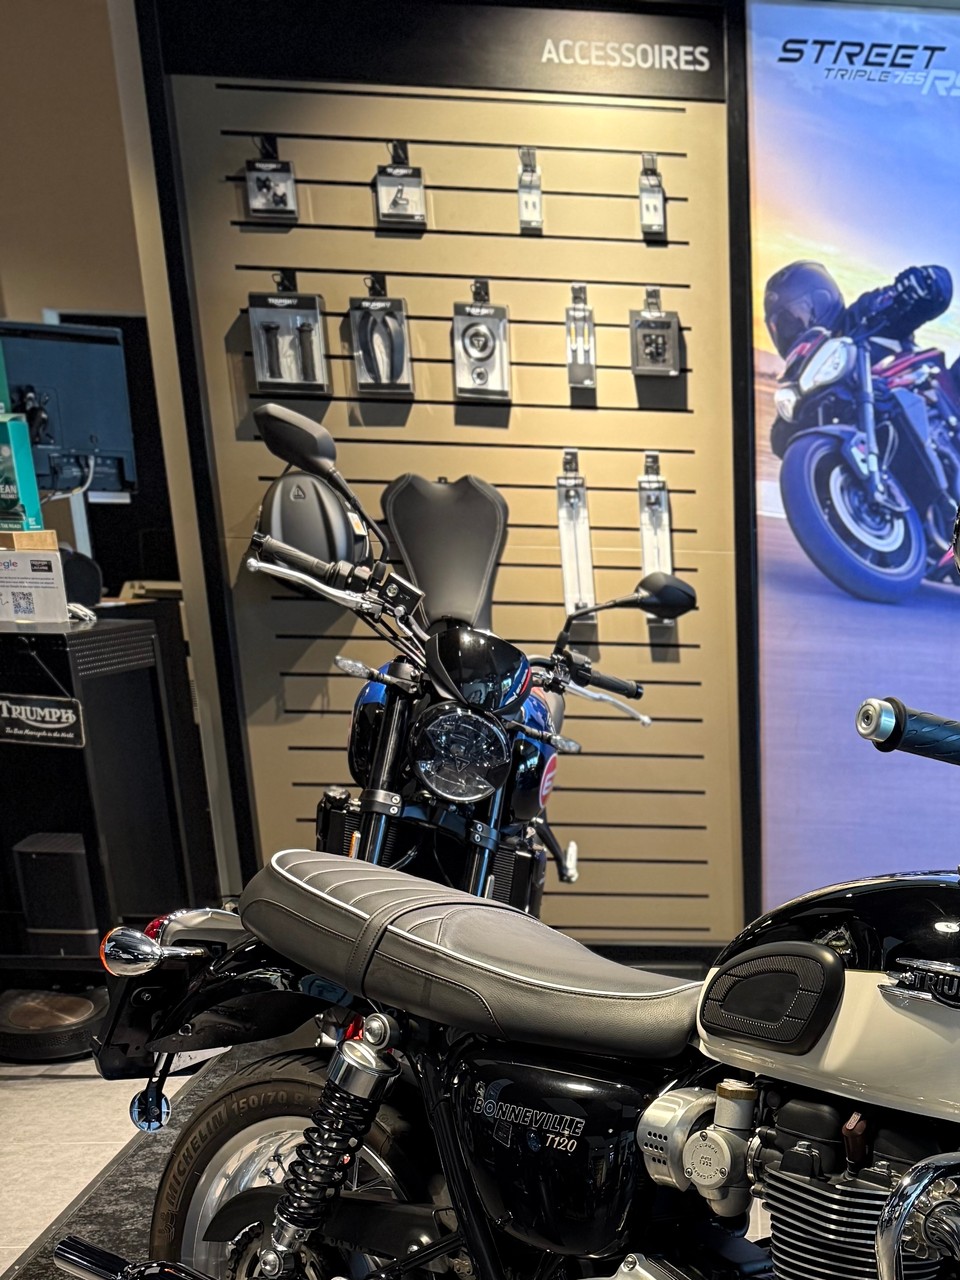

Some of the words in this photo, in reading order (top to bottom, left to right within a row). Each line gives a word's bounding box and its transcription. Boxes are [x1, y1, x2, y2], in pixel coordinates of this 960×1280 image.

[541, 38, 711, 72] ACCESSOIRES
[778, 38, 946, 69] STREET
[824, 68, 891, 83] TRIPLE
[893, 71, 926, 85] 765
[0, 700, 77, 729] TRIUMPH
[232, 1093, 287, 1115] 150/70
[473, 1097, 586, 1137] BONNEVILLE
[166, 1108, 228, 1207] MICHELIN
[545, 1133, 577, 1152] T120
